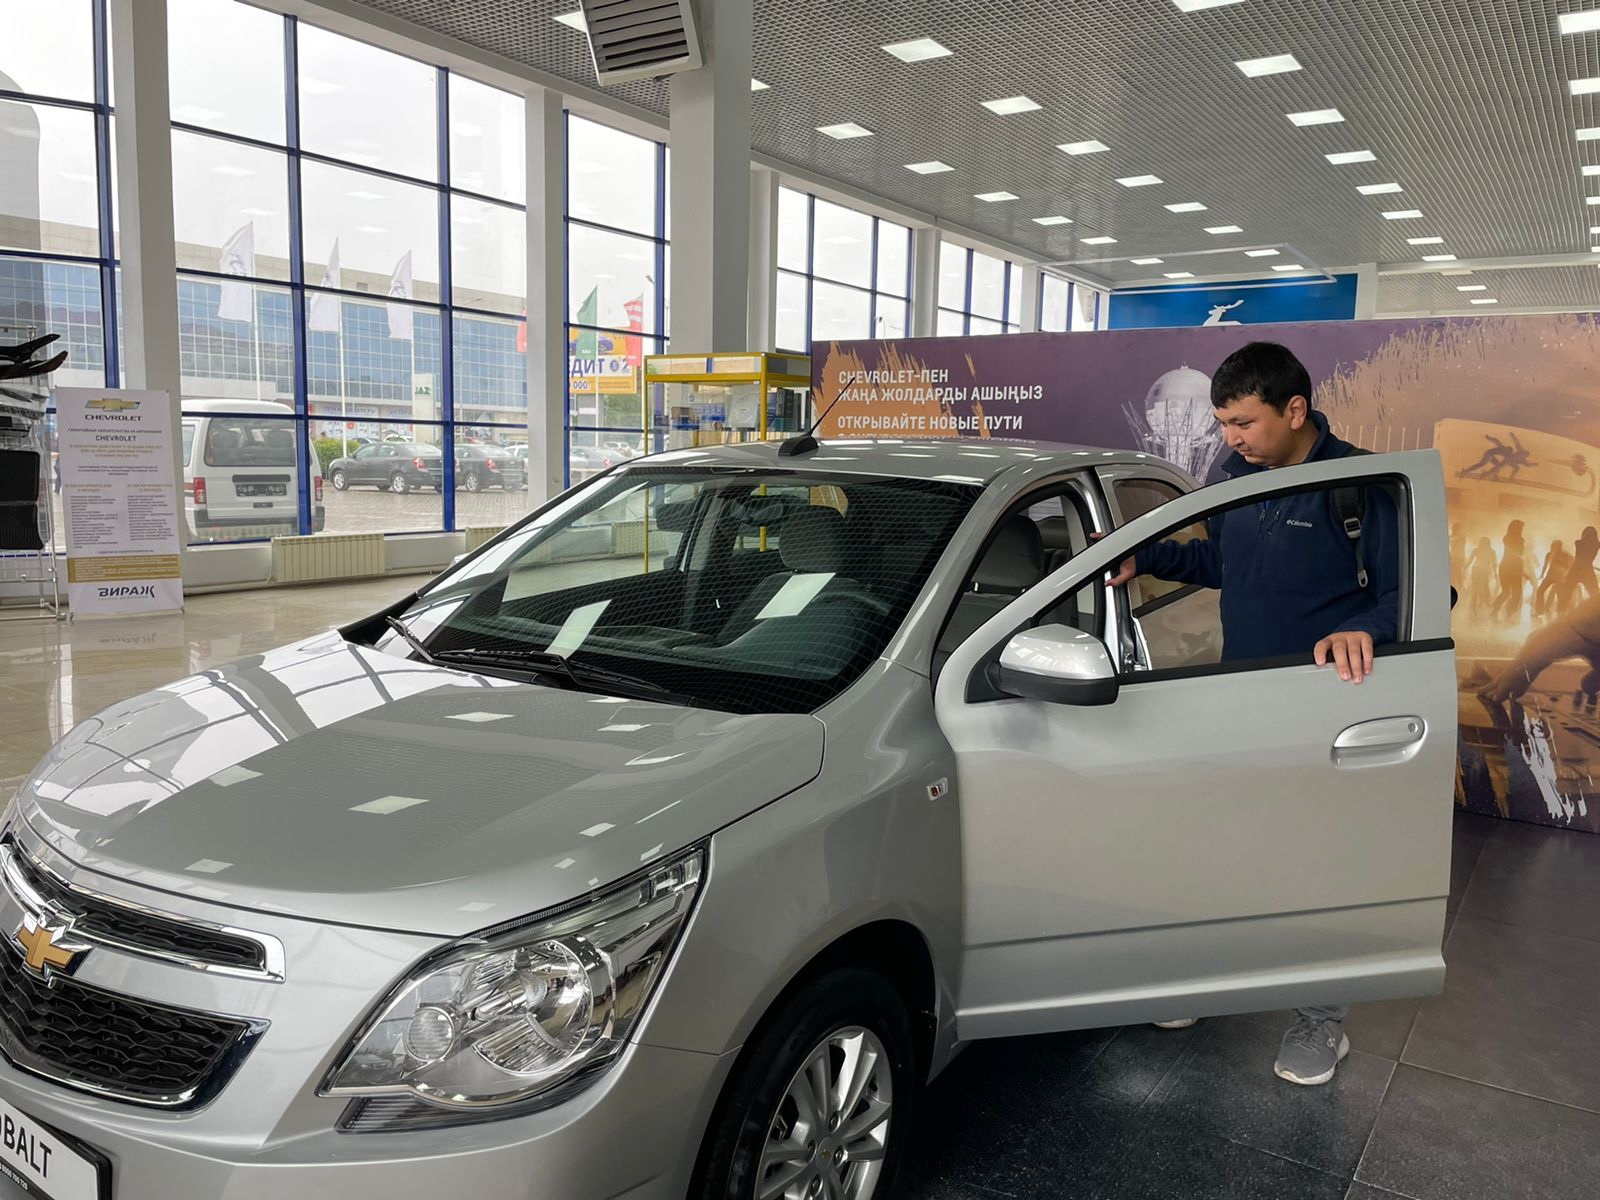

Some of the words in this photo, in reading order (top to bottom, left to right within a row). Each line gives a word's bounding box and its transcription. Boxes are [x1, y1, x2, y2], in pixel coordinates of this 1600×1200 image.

[838, 369, 949, 384] CHEVROLET-ПЕН
[838, 388, 877, 405] ЖАҢА
[881, 386, 968, 405] ЖОЛДАРДЫ
[971, 385, 1043, 404] АШЫҢЫЗ
[85, 414, 142, 422] CHEVROLET
[837, 412, 926, 430] ОТКРЫВАЙТЕ
[929, 415, 979, 430] НОВЫЕ
[983, 415, 1023, 430] ПУТИ
[95, 434, 137, 442] CHEVROLET
[97, 586, 155, 598] ВИРАЖ
[0, 1114, 52, 1179] BALT
